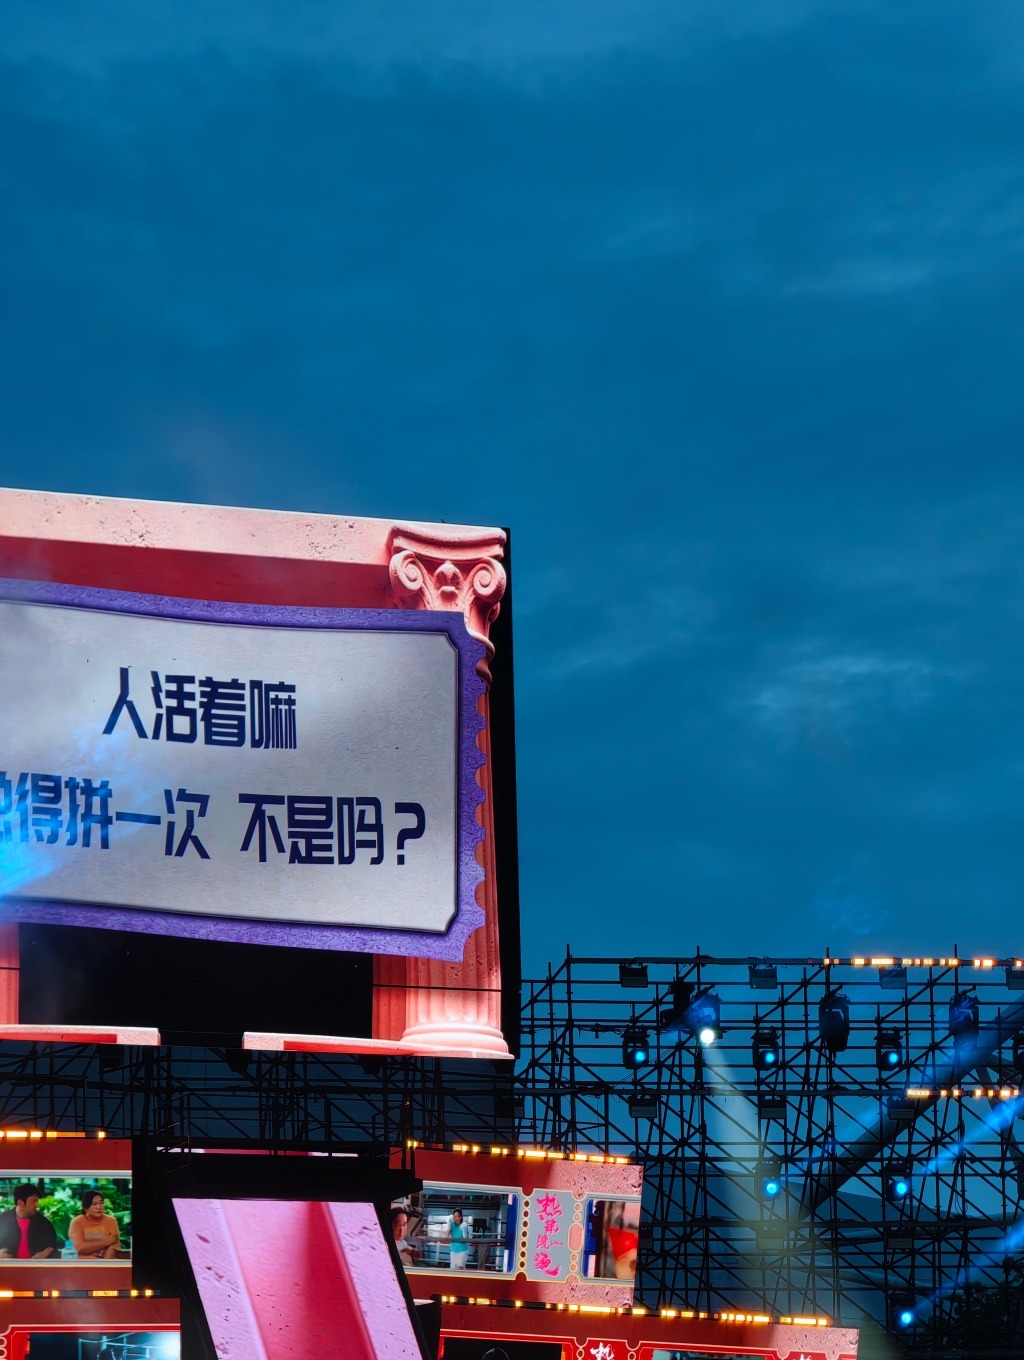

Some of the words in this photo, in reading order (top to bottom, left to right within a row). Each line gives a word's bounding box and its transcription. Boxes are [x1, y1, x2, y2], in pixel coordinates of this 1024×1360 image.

[102, 667, 297, 750] 人活着嘛
[0, 770, 211, 860] 得拼一次
[239, 792, 427, 866] 不是吗?
